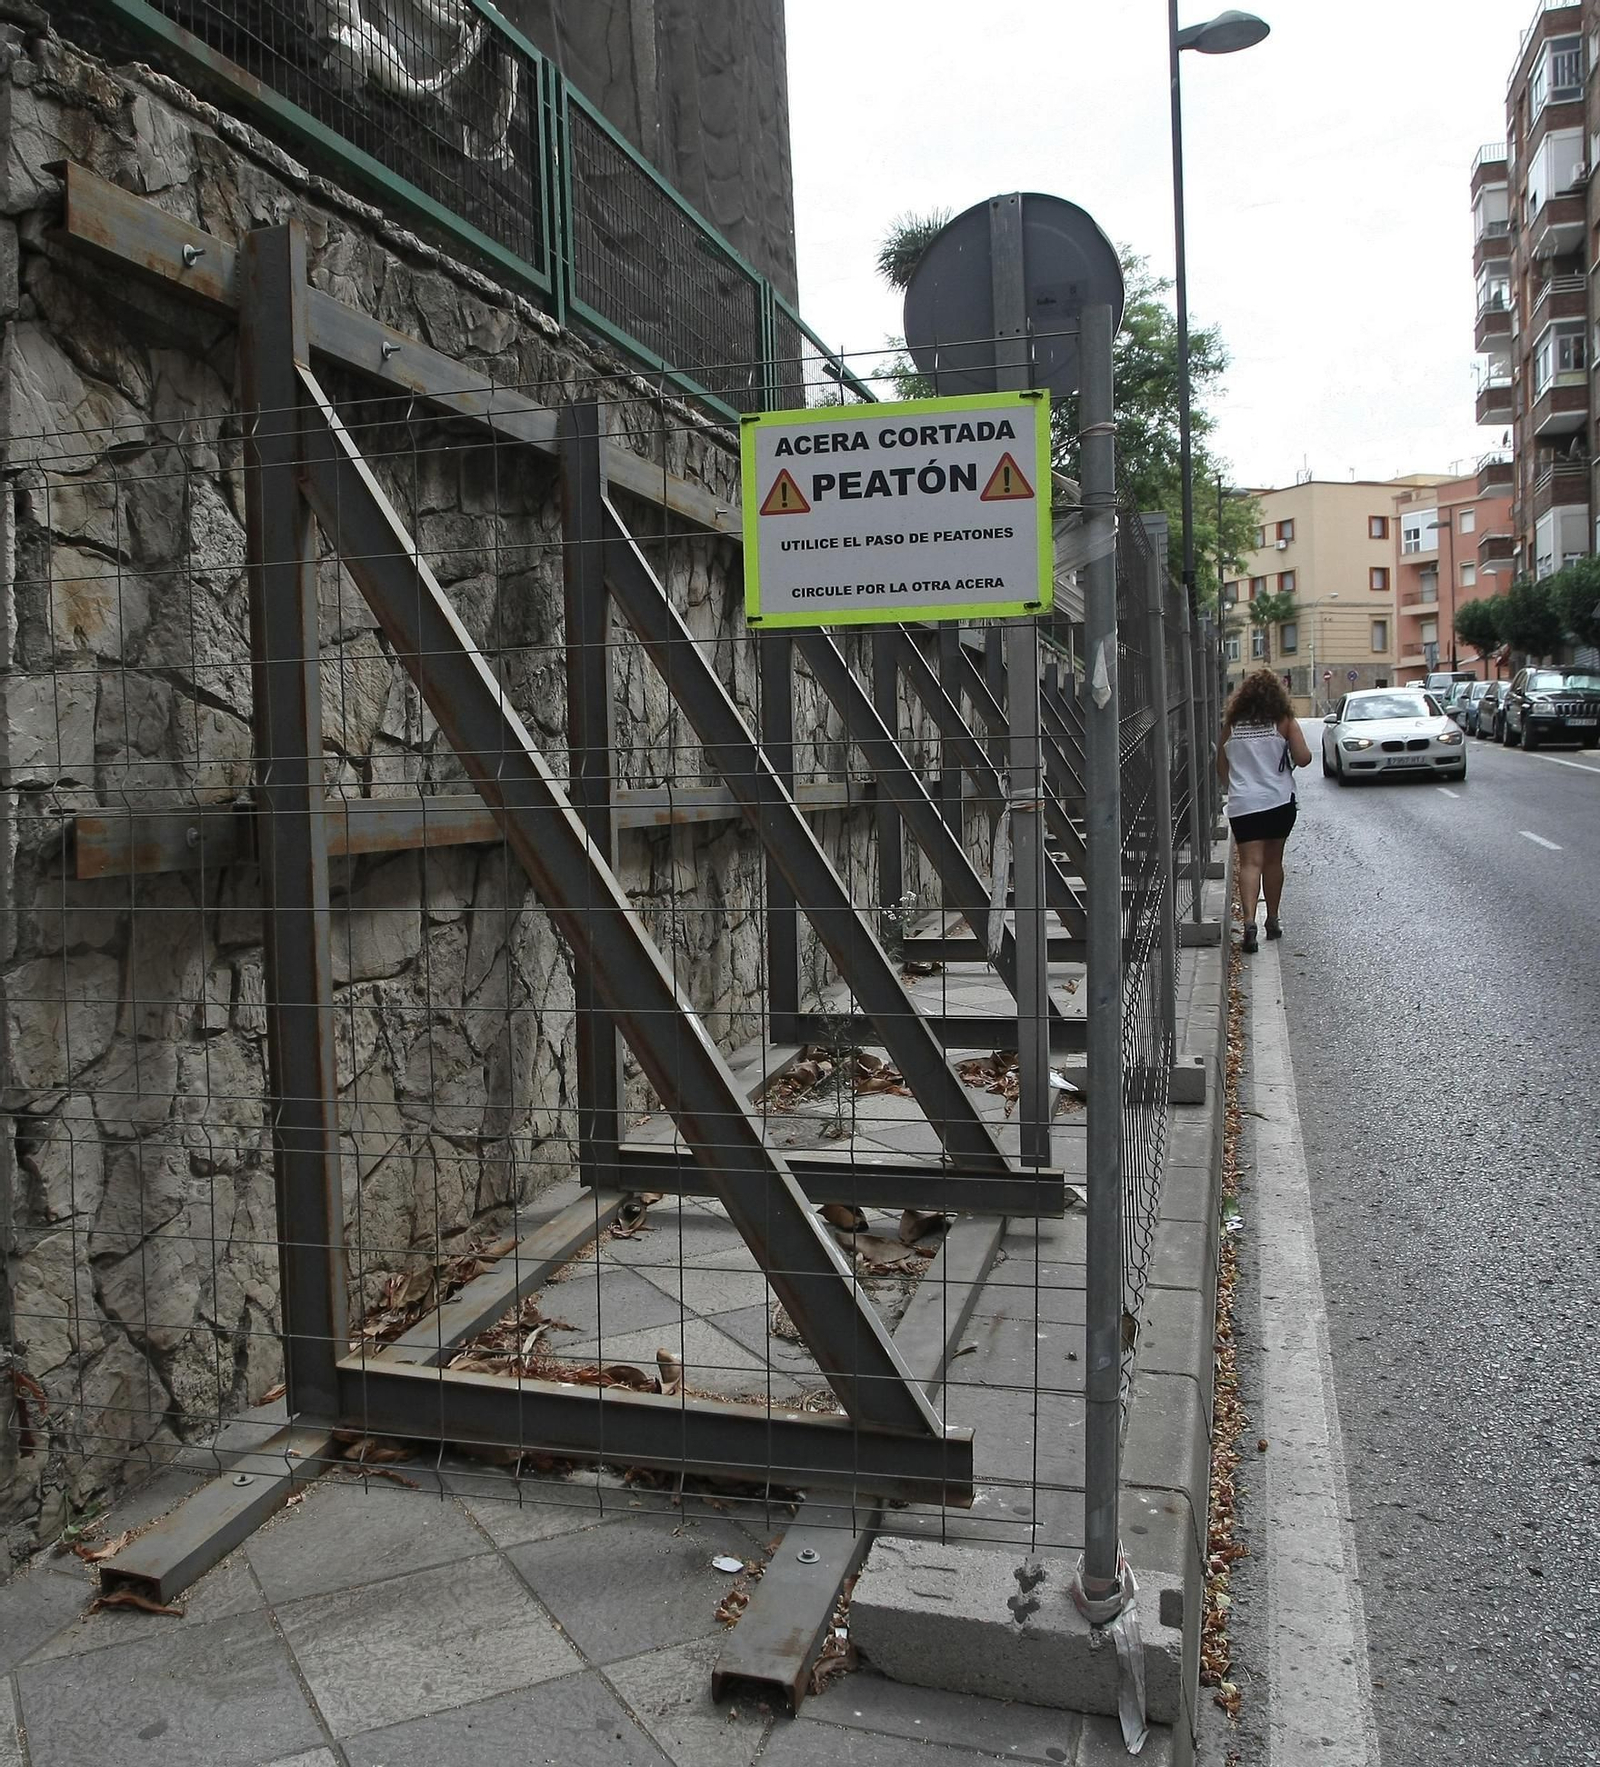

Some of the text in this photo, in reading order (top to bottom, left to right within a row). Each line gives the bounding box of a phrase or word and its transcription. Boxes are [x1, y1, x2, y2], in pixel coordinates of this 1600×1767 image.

[774, 419, 1016, 457] ACERA CORTADA
[812, 458, 978, 502] PEATÓN
[780, 527, 1014, 552] UTILICE EL PASO DE PEATONES
[791, 577, 1005, 599] CIRCULE POR LA OTRA ACERA
